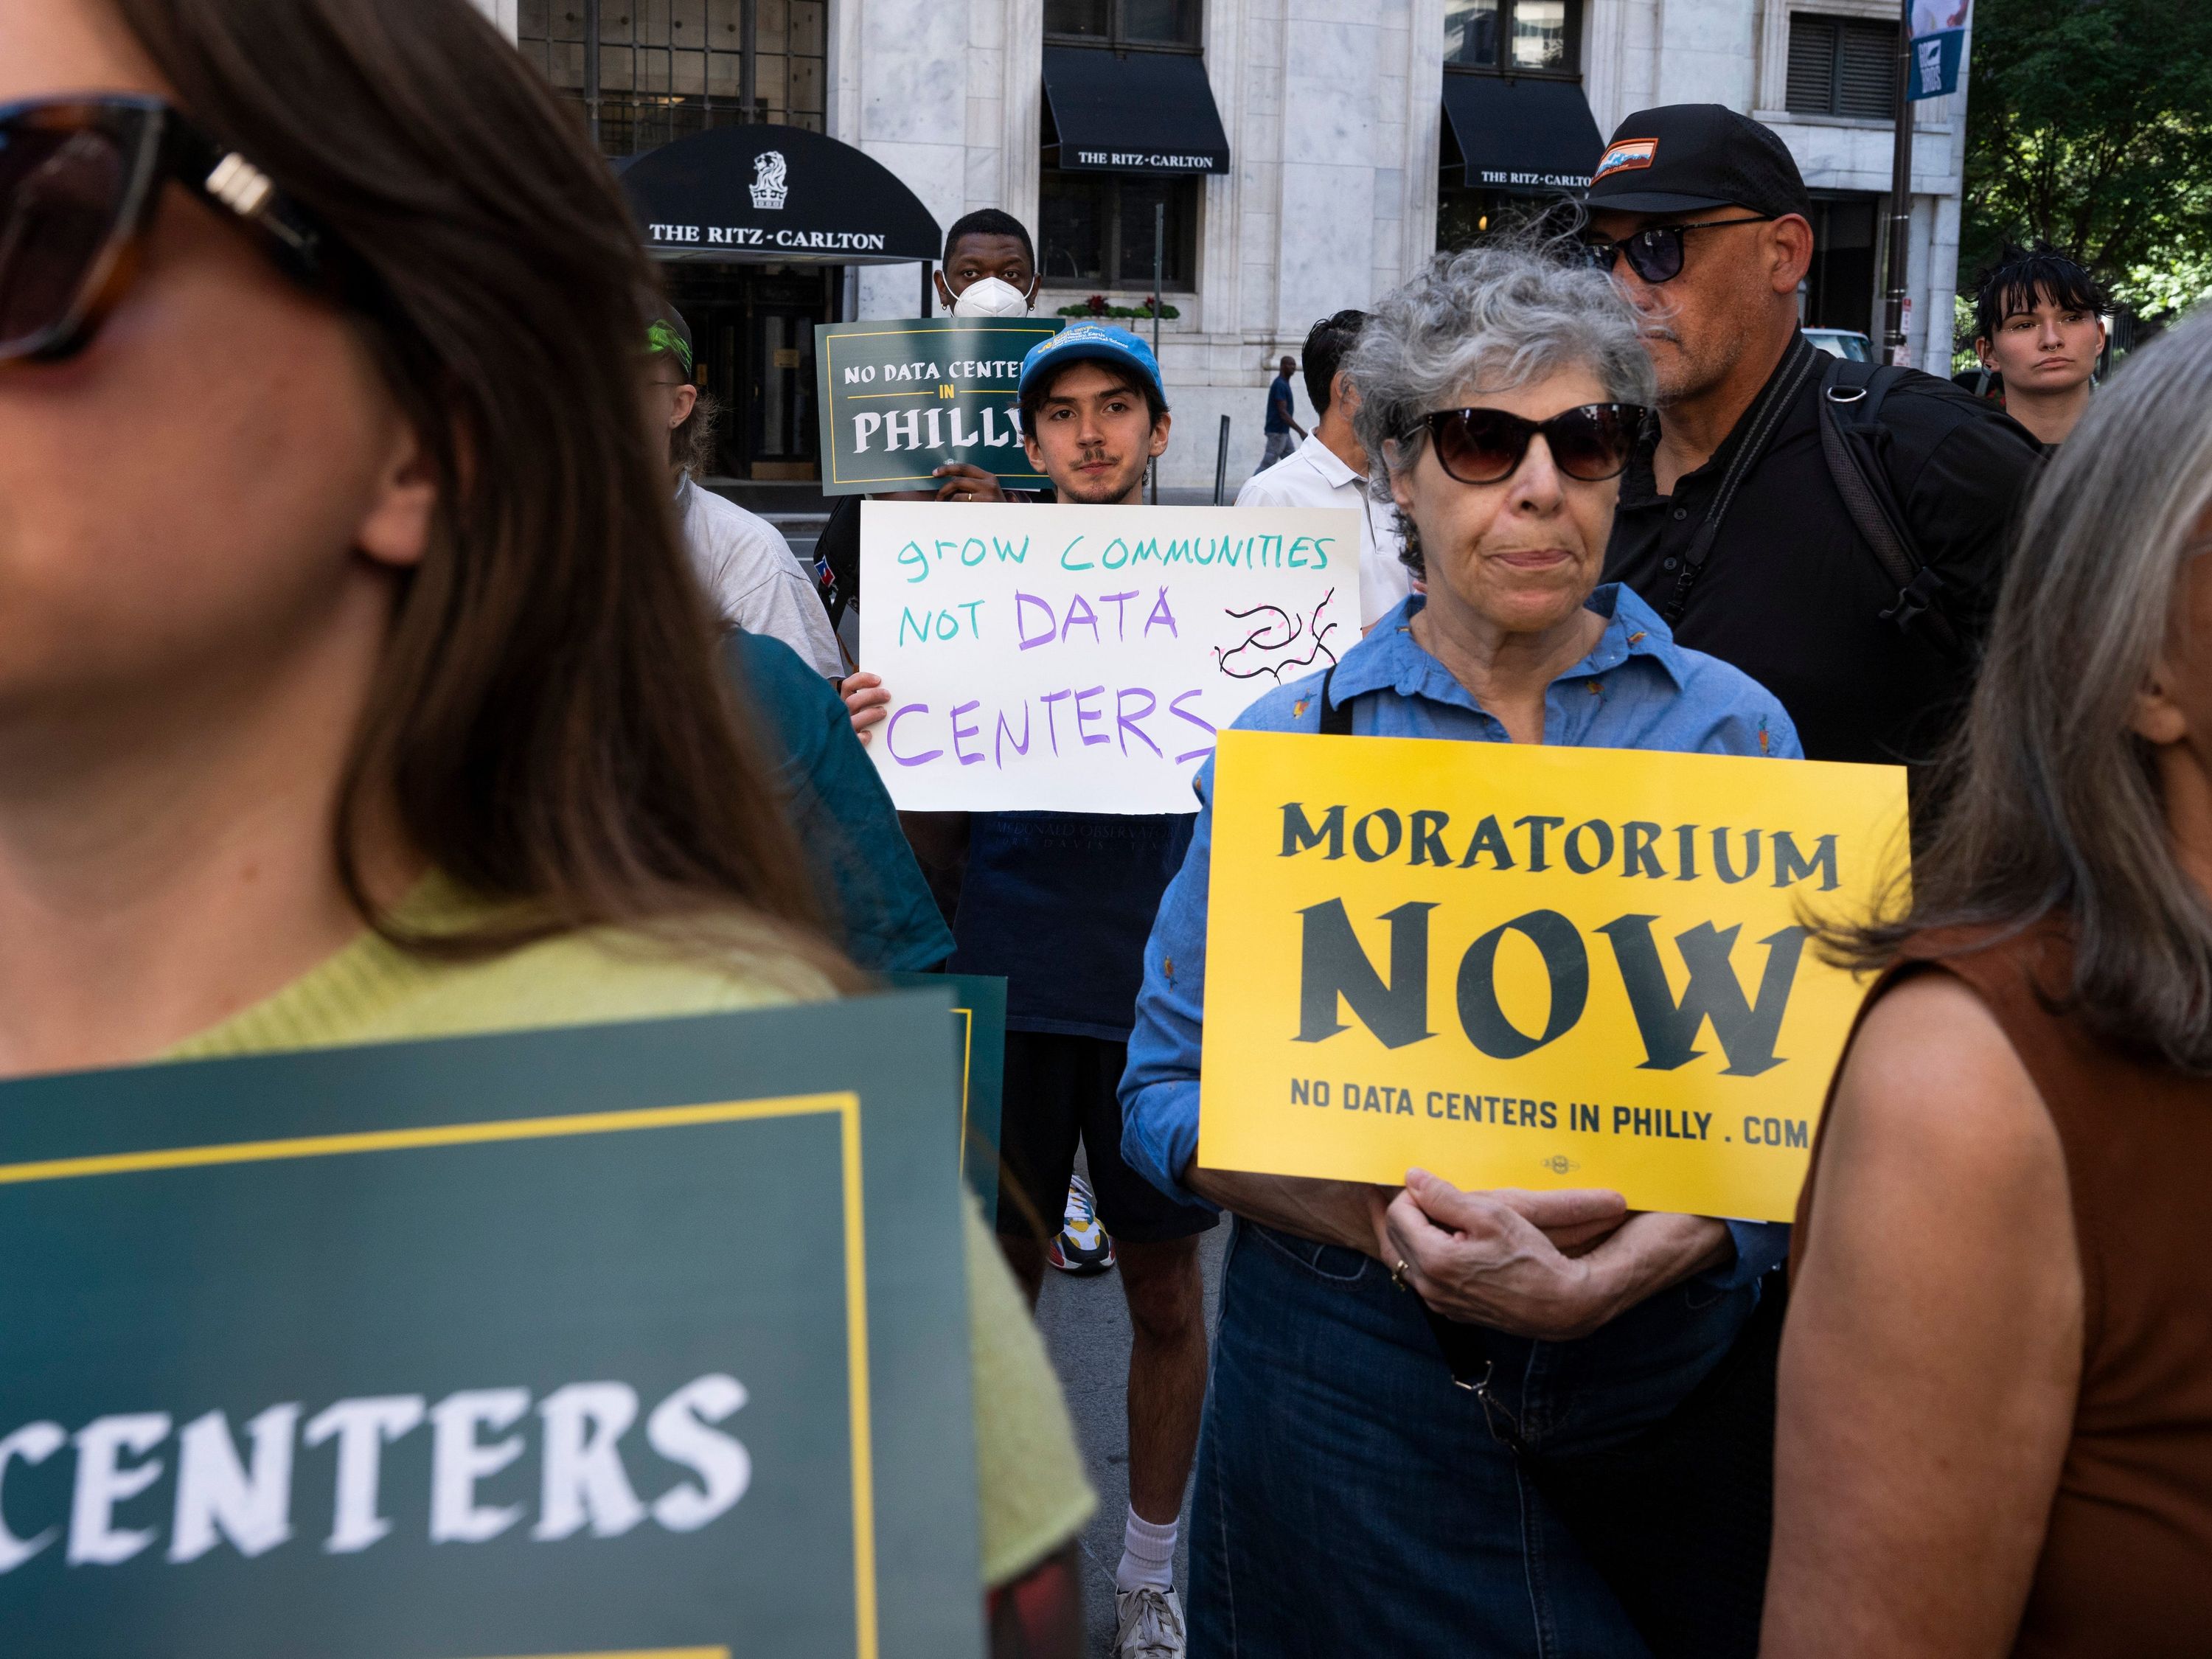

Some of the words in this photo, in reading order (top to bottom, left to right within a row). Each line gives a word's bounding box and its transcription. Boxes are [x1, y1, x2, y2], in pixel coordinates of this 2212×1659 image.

[1078, 151, 1107, 164] THE
[1481, 170, 1507, 182] THE
[1511, 172, 1593, 187] RITZ-CARLTO
[649, 223, 700, 242] THE
[707, 226, 885, 250] RITZ-CARLTON
[844, 365, 876, 384] NO
[883, 361, 942, 382] DATA
[948, 361, 1024, 378] CENTE
[939, 384, 954, 399] IN
[1060, 534, 1336, 571] COMMUNITIES
[899, 599, 985, 647] NOT
[1015, 585, 1178, 650] DATA
[886, 685, 1217, 771] CENTERS
[1080, 825, 1175, 838] OBSERVATOR
[1278, 802, 1842, 891] MORATORIUM
[1291, 897, 1811, 1077] NOW
[1291, 1079, 1330, 1107] NO
[1344, 1084, 1413, 1116] DATA
[1427, 1091, 1557, 1130] CENTERS
[1570, 1103, 1600, 1133] IN
[1613, 1106, 1712, 1141] PHILLY
[1743, 1116, 1808, 1148] COM
[0, 1372, 753, 1575] CENTERS
